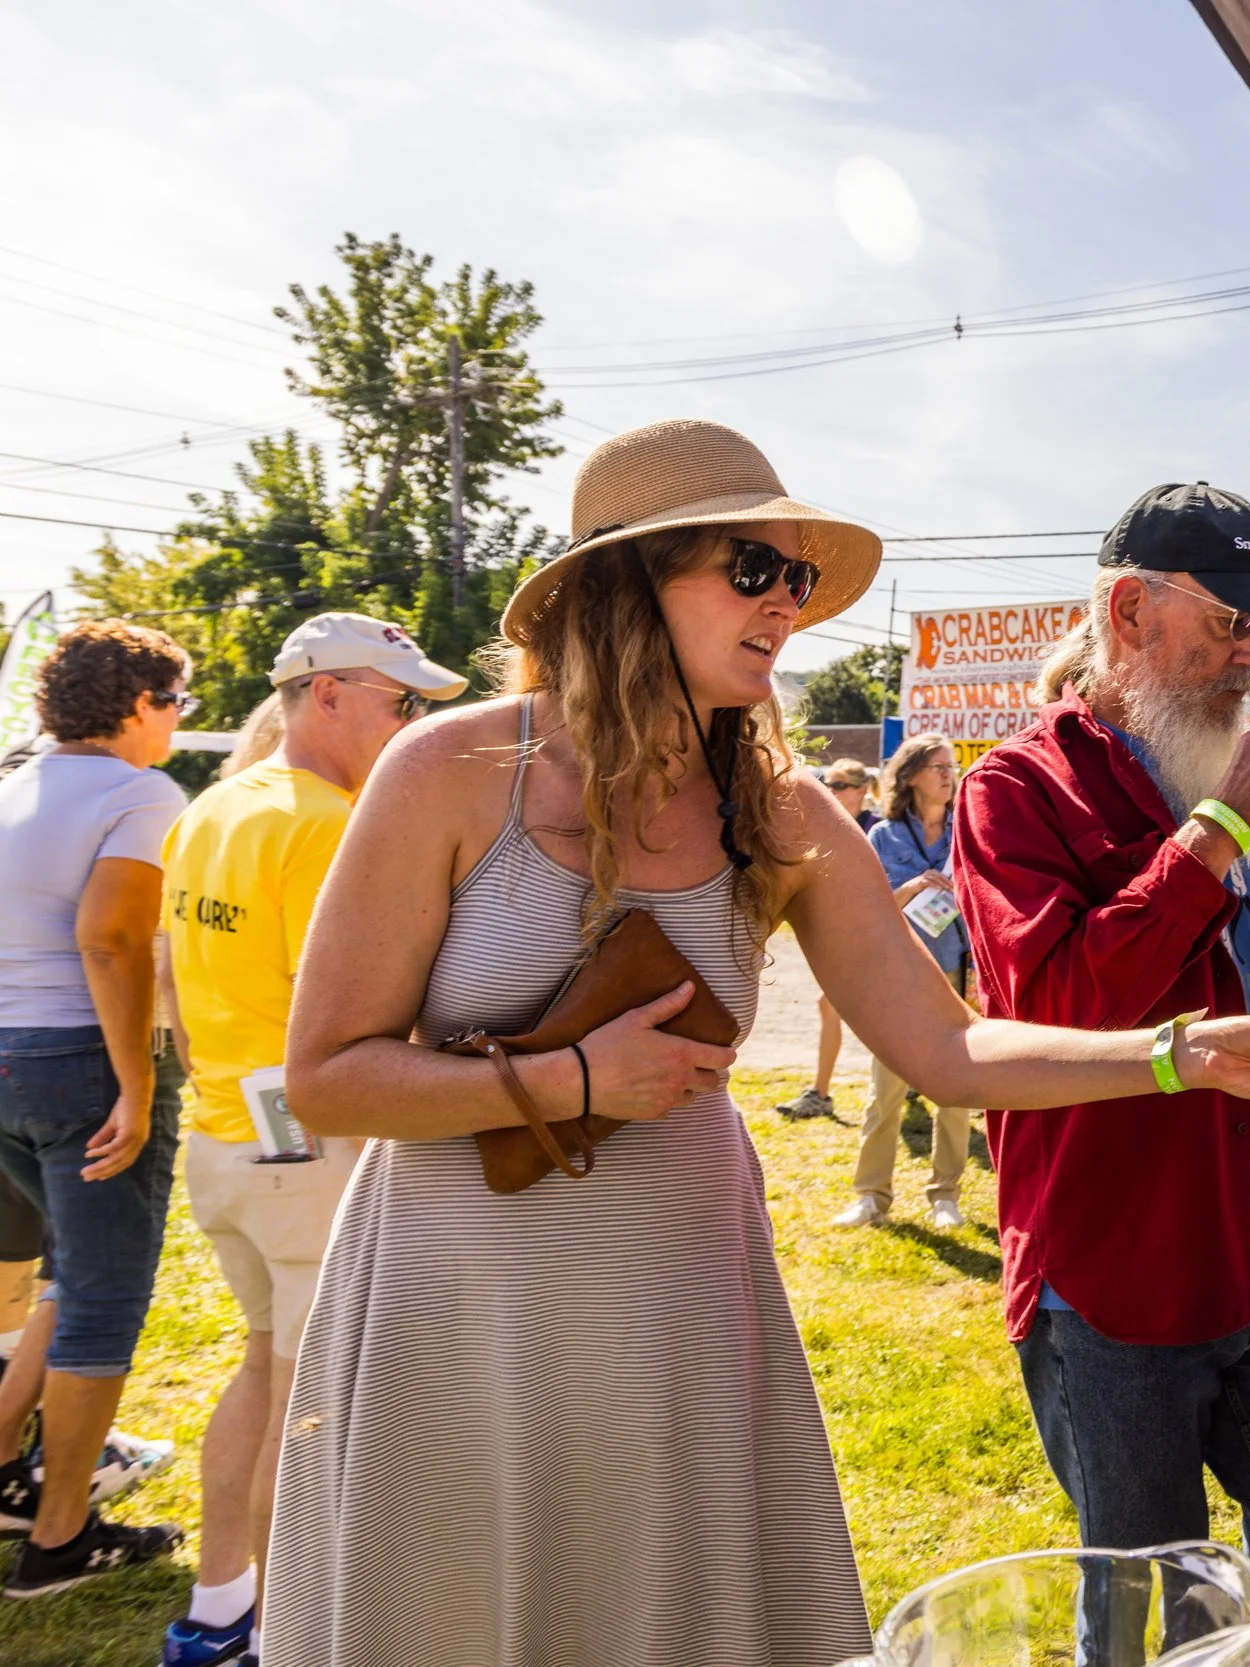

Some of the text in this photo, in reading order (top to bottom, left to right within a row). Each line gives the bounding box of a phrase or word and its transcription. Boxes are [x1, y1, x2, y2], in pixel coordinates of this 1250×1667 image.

[908, 684, 962, 710] CRAB
[963, 682, 1006, 709] MAC
[1008, 681, 1022, 709] &
[907, 712, 965, 738] CREAM
[969, 712, 993, 738] OF
